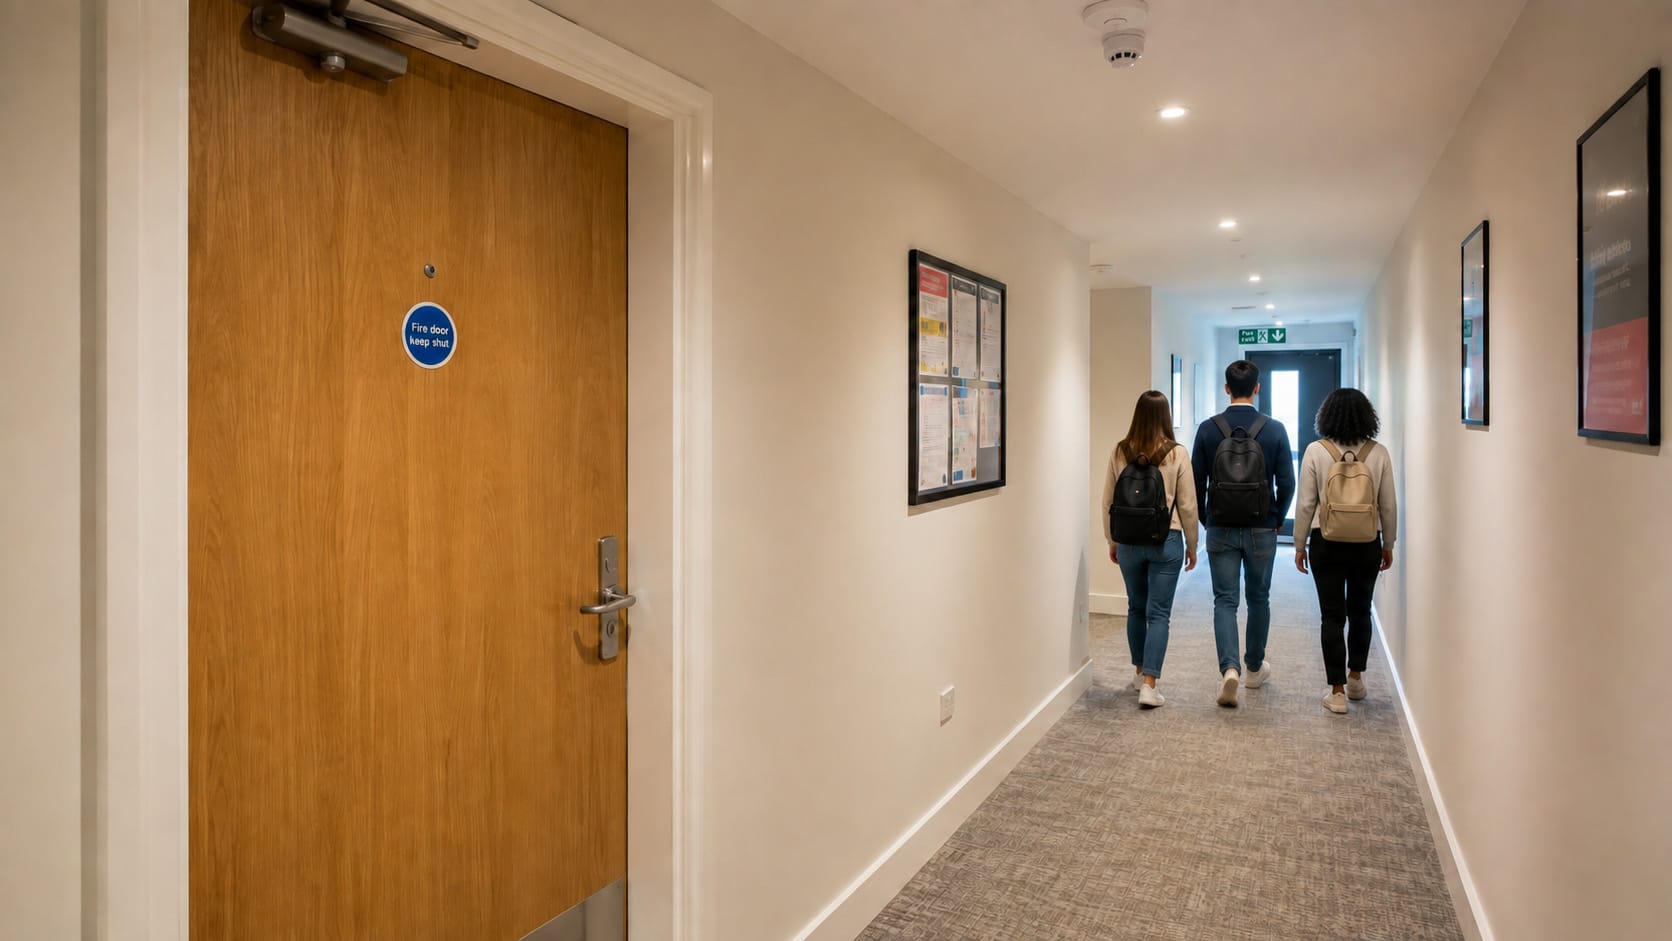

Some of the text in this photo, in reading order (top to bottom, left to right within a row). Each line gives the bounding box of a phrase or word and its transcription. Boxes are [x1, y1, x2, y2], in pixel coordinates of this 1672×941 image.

[411, 322, 449, 335] Fire door
[409, 335, 449, 349] keep shut
